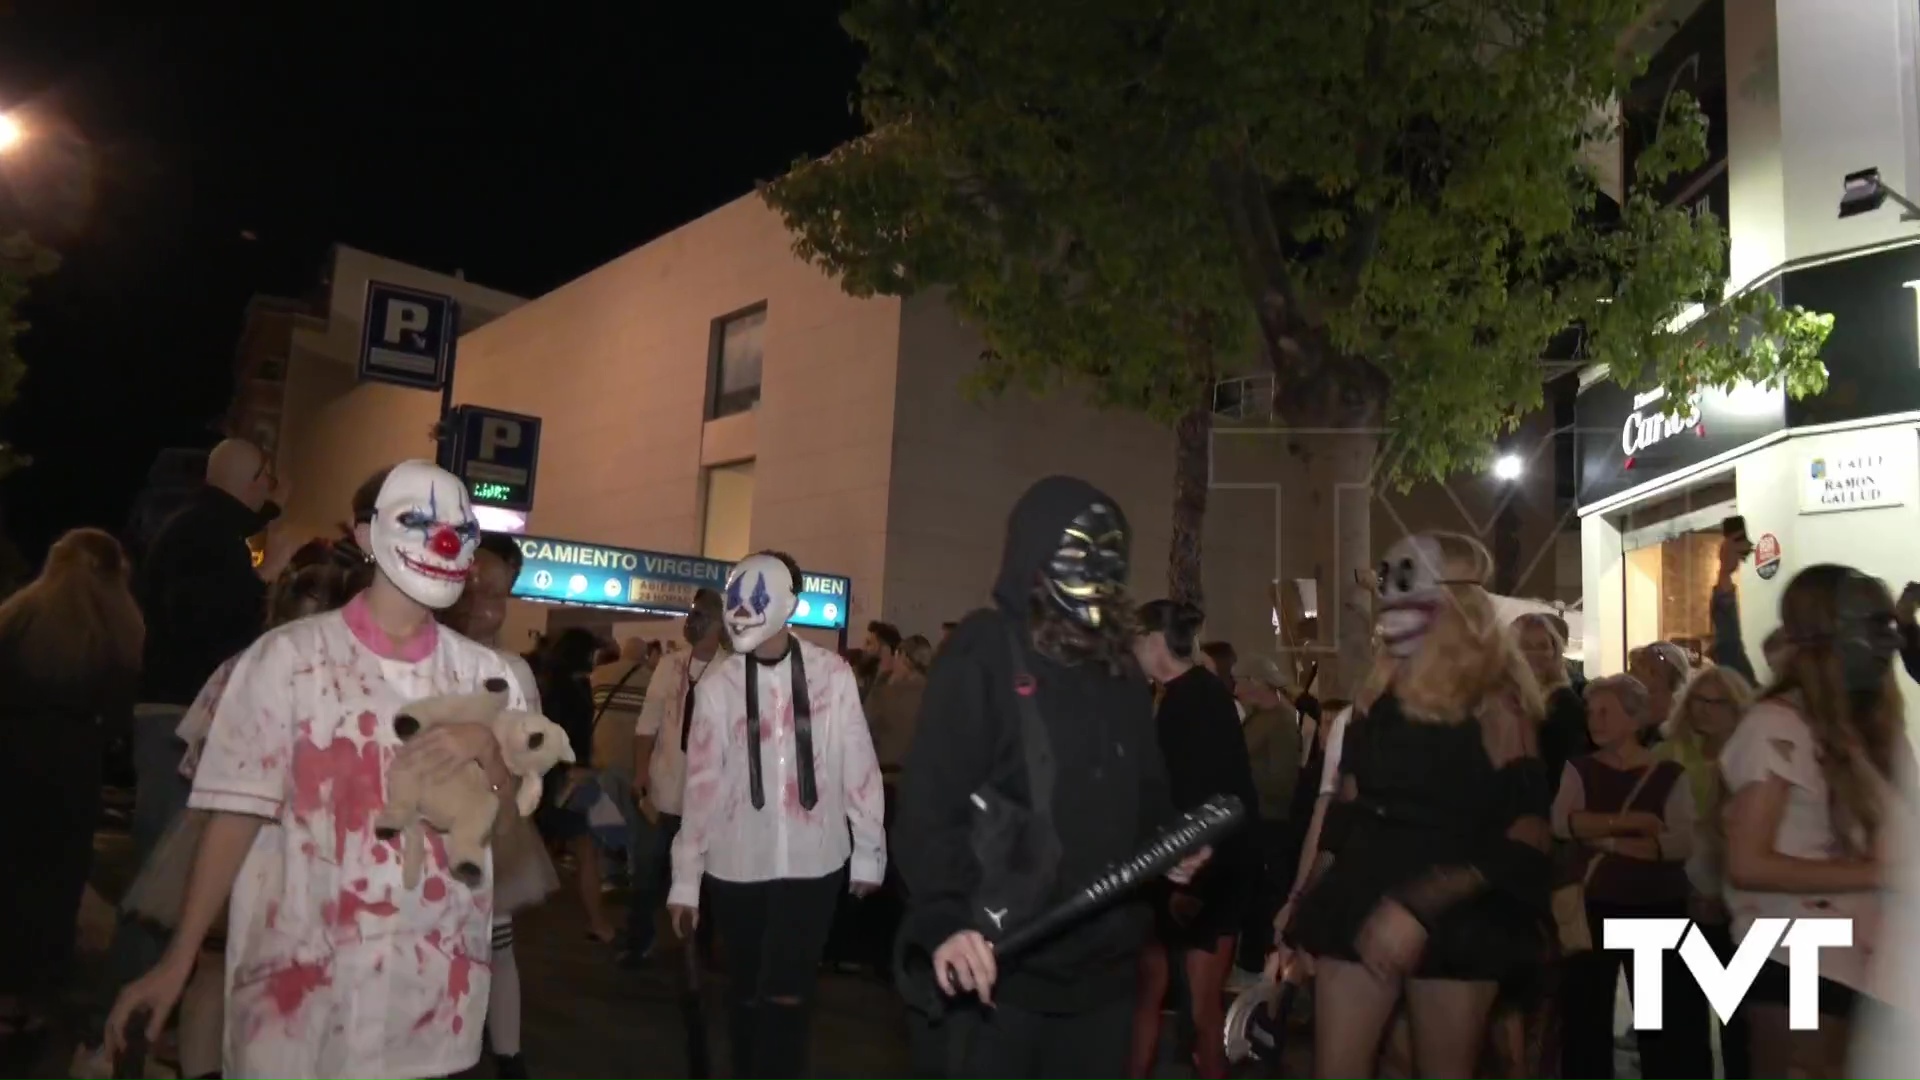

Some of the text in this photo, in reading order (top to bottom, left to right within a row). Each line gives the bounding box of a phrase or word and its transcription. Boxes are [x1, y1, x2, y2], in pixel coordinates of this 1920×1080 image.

[383, 298, 429, 344] P
[479, 416, 521, 460] P
[512, 539, 638, 571] CAMIENTO
[643, 555, 719, 581] VIRGEN
[803, 574, 844, 596] MEN
